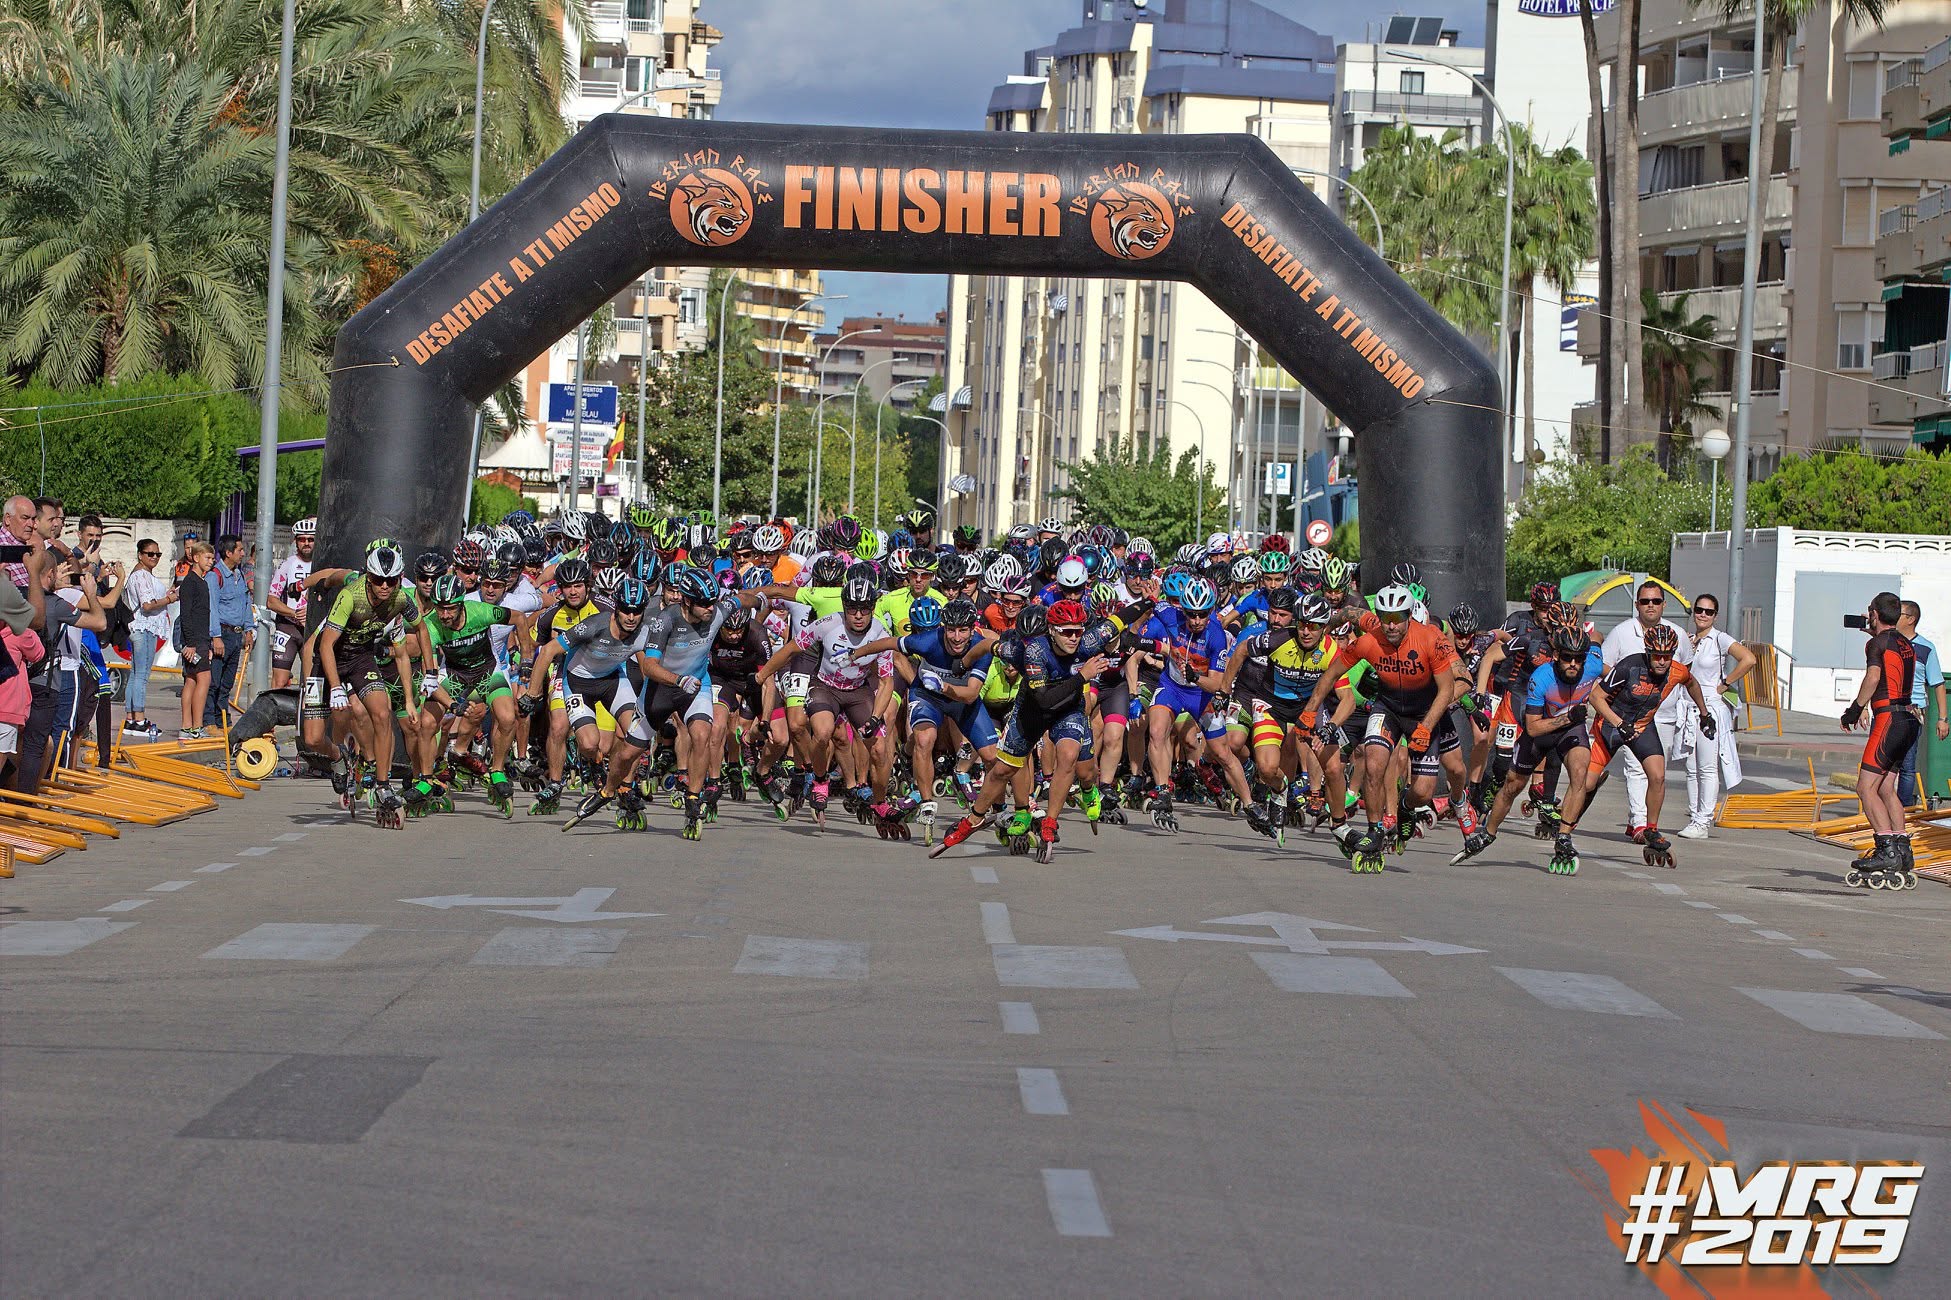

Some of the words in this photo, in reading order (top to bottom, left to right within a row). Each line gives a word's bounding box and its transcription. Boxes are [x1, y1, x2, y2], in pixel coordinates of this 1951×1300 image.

[784, 166, 1060, 236] FINISHER
[405, 271, 514, 366] DESAFIATE
[508, 256, 535, 283] A
[523, 238, 555, 268] TI
[545, 182, 621, 252] MISMO
[1220, 202, 1323, 303] DESAFIATE
[1315, 294, 1340, 321] A
[1332, 307, 1362, 339] TI
[1350, 327, 1425, 399] MISMO
[1498, 727, 1515, 739] 49
